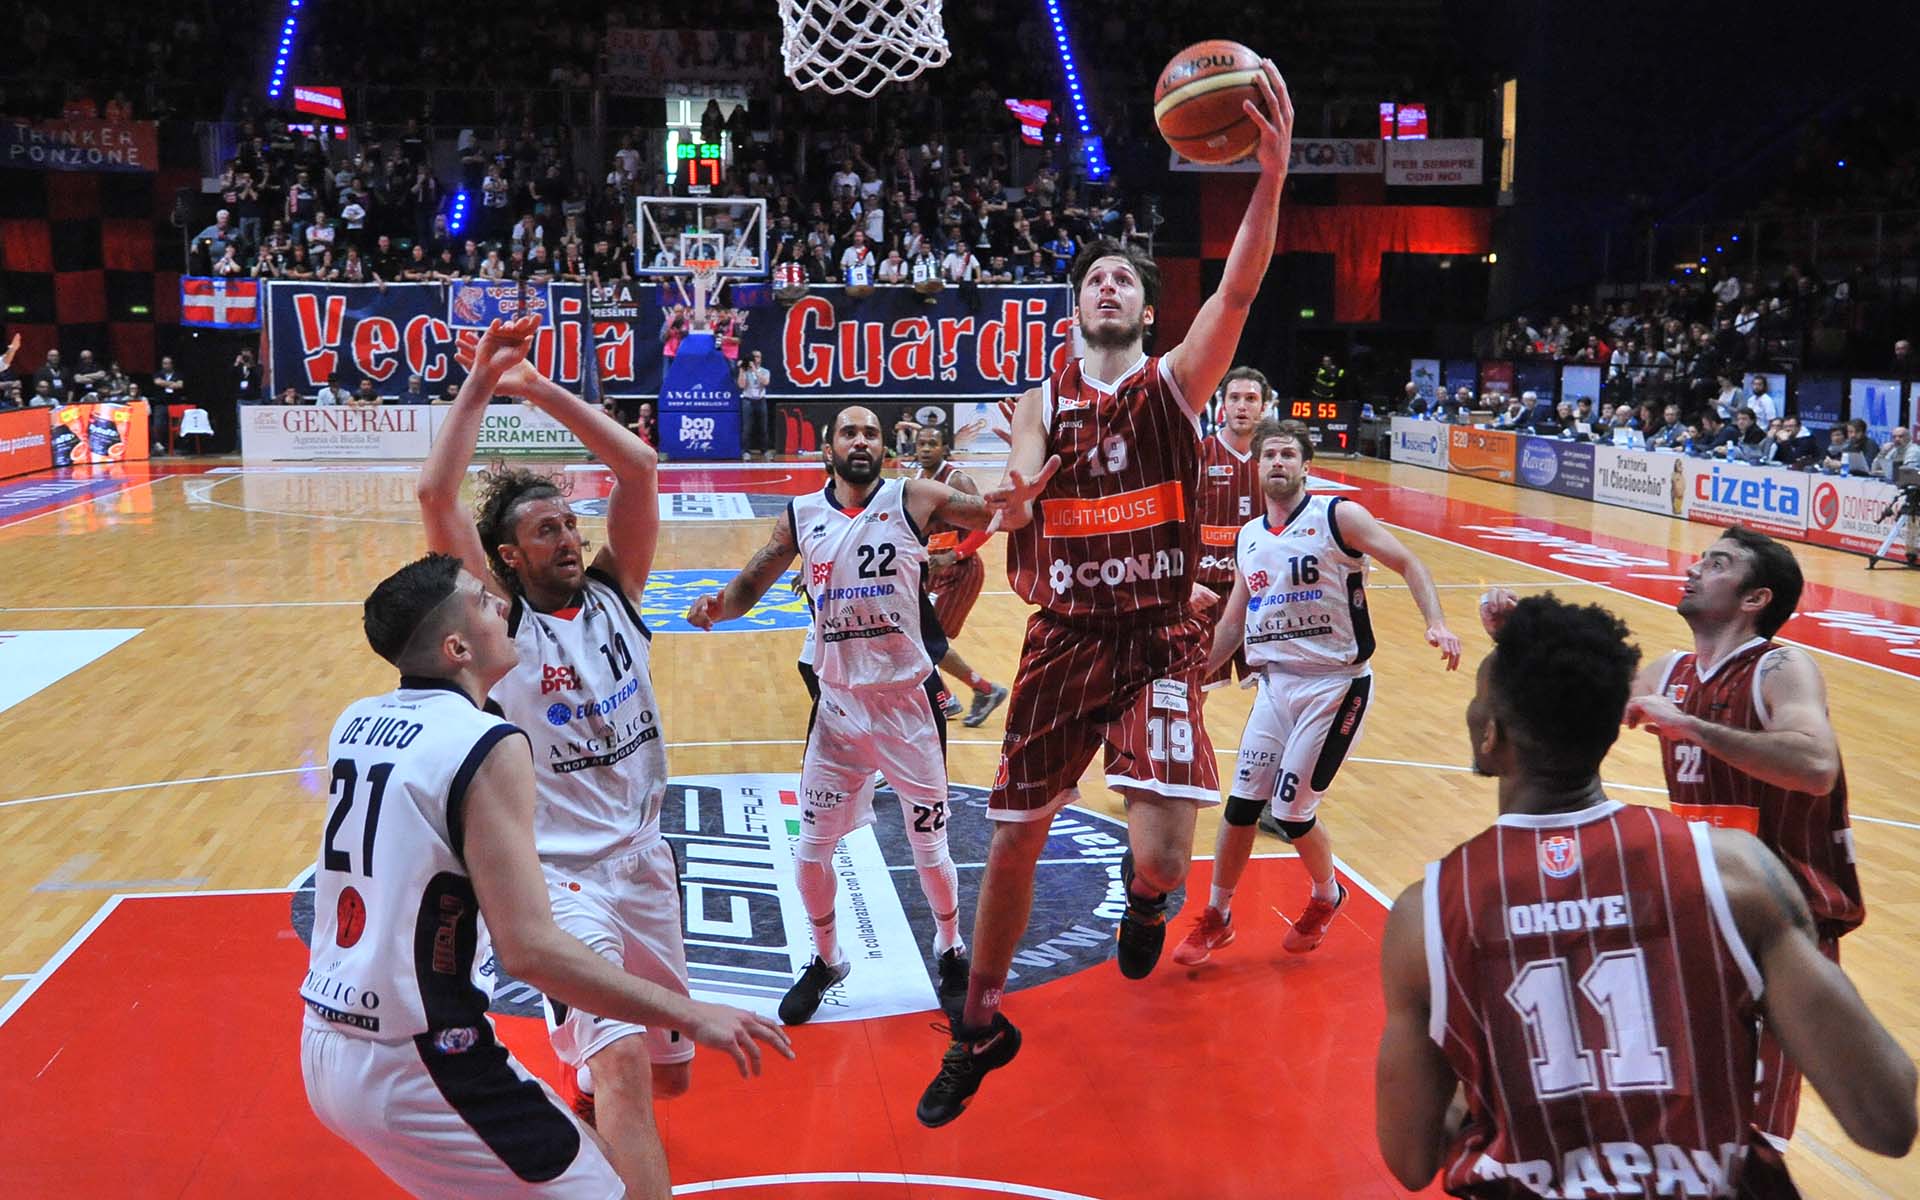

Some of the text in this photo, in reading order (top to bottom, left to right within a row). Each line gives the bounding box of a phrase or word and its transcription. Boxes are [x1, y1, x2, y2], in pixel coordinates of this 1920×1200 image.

[10, 145, 140, 166] PONZONE
[677, 144, 719, 158] 05 55
[689, 159, 720, 185] 17
[294, 294, 635, 386] Vecia
[666, 391, 732, 399] ANGELICO
[282, 409, 417, 433] GENERALI
[681, 415, 715, 431] bon
[1292, 402, 1337, 418] 05 55
[477, 429, 576, 443] ERRAMENTI
[679, 429, 713, 442] prix
[1327, 423, 1348, 431] GUEST
[1338, 432, 1348, 448] 7
[1087, 433, 1128, 477] 19
[1616, 455, 1647, 473] Trattoria
[1695, 466, 1800, 516] cizeta
[1052, 498, 1157, 527] LIGHTHOUSE
[1239, 495, 1251, 516] 5
[857, 542, 897, 579] 22
[1288, 554, 1320, 586] 16
[338, 716, 424, 750] DE VICO
[1146, 716, 1194, 762] 19
[1243, 749, 1277, 762] HYPE
[1675, 745, 1705, 783] 22
[805, 788, 843, 803] HYPE
[1273, 767, 1300, 803] 16
[324, 758, 396, 878] 21
[912, 800, 945, 833] 22
[845, 876, 863, 892] con
[849, 892, 880, 947] collaborazione
[1509, 895, 1629, 936] OKOYE
[864, 947, 884, 960] in
[1505, 947, 1673, 1098] 11
[1473, 1142, 1749, 1199] RAPAN
